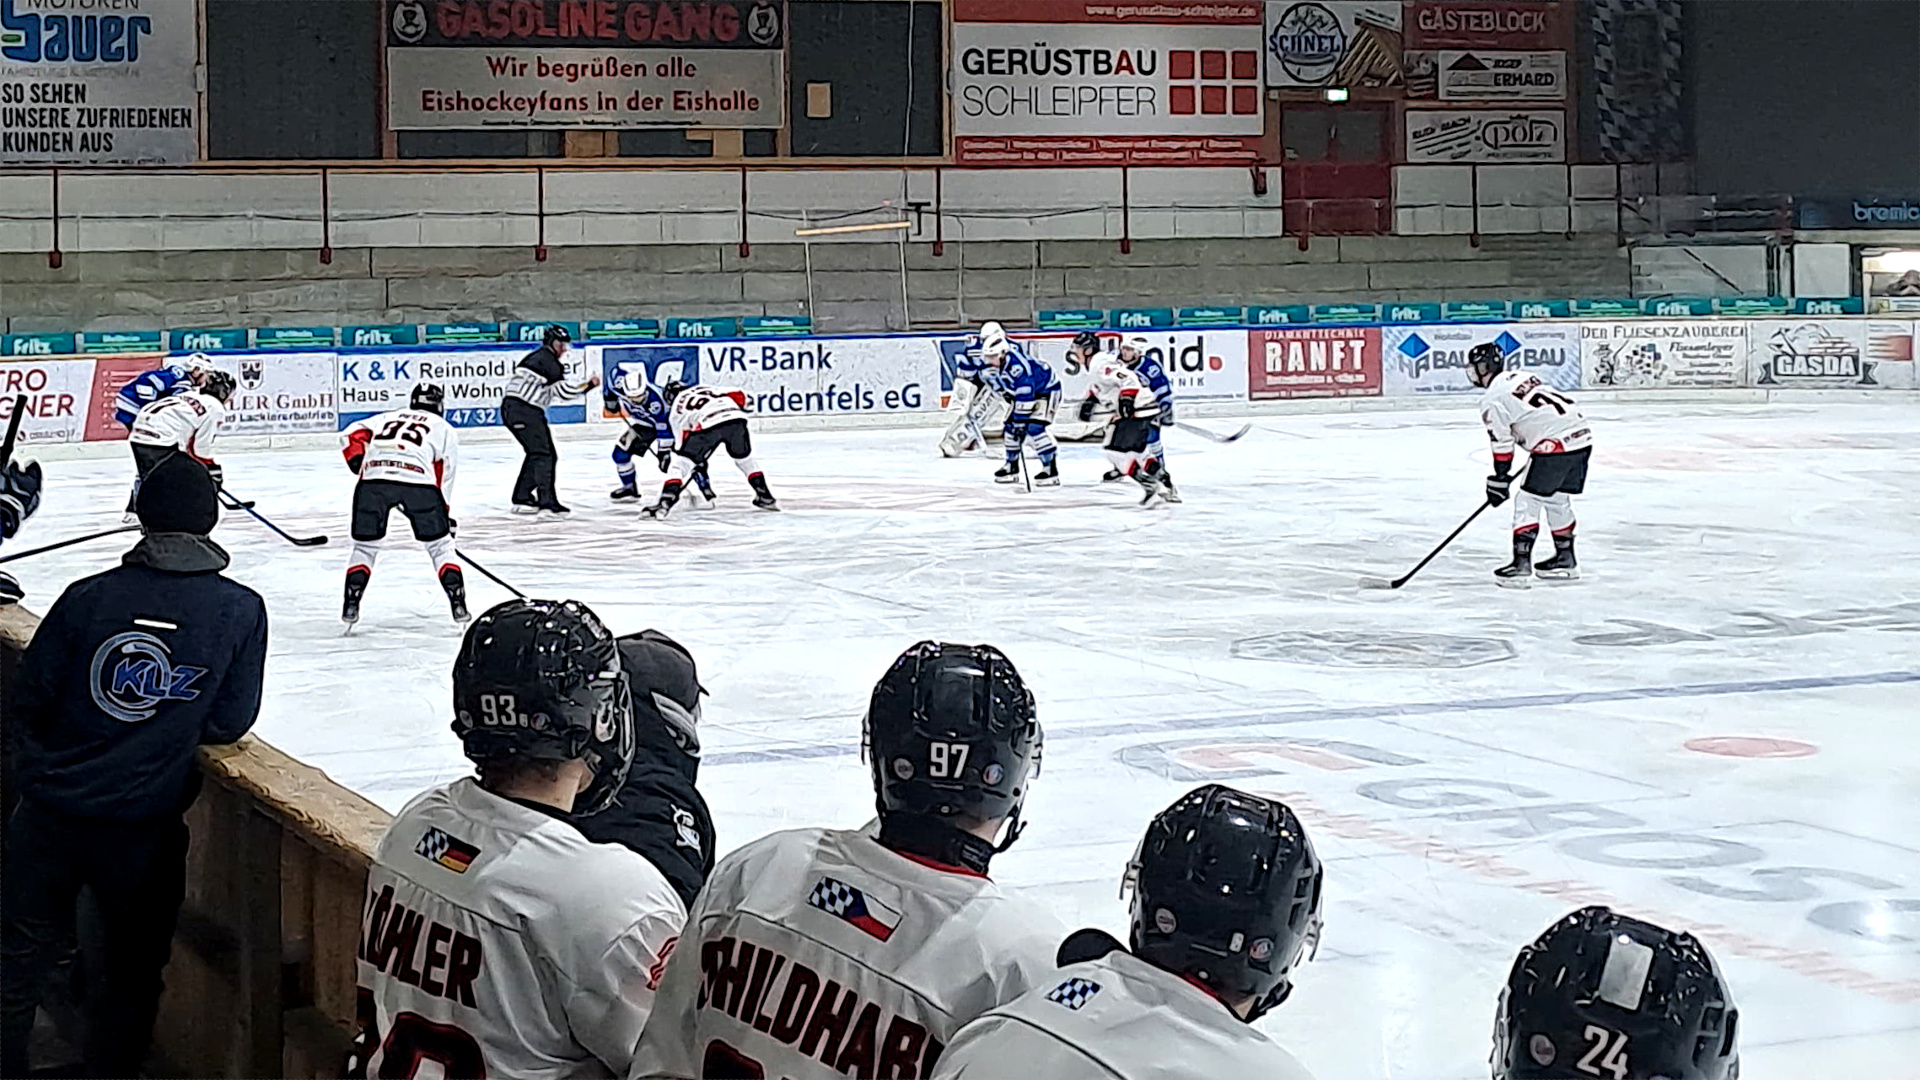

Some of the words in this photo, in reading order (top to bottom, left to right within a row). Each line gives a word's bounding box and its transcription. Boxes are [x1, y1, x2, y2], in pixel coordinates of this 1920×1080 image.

[437, 1, 619, 38] GASOLINE
[623, 2, 740, 41] GANG
[1418, 7, 1545, 32] GÄSTEBLOCK
[486, 56, 528, 77] Wir
[537, 56, 647, 82] begrüßen
[655, 56, 696, 77] alle
[962, 42, 1157, 75] GERÜSTBAU
[2, 84, 24, 103] SO
[30, 84, 86, 104] SEHEN
[421, 90, 588, 116] Eishockeyfans
[598, 90, 617, 111] in
[626, 90, 663, 111] der
[673, 90, 759, 111] Eishalle
[962, 85, 1157, 116] SCHLEIPFER
[2, 108, 71, 128] UNSERE
[76, 108, 192, 129] ZUFRIEDENEN
[2, 132, 73, 153] KUNDEN
[80, 132, 113, 153] AUS
[355, 329, 393, 345] Fritz
[678, 322, 713, 338] Fritz
[708, 345, 833, 372] VR-Bank
[1266, 340, 1365, 372] RANFT
[1778, 356, 1856, 376] GASDA
[343, 362, 359, 381] K
[368, 361, 384, 381] &
[394, 360, 410, 379] K
[419, 360, 505, 379] Reinhold
[276, 393, 333, 409] GmbH
[343, 388, 389, 402] Haus
[451, 383, 503, 399] Wohn
[745, 383, 874, 413] erdenfels
[884, 384, 921, 409] eG
[452, 409, 470, 425] 47
[475, 408, 496, 424] 32
[112, 657, 209, 701] KLZ
[481, 694, 516, 726] 93
[930, 741, 970, 779] 97
[1577, 1024, 1629, 1080] 24
